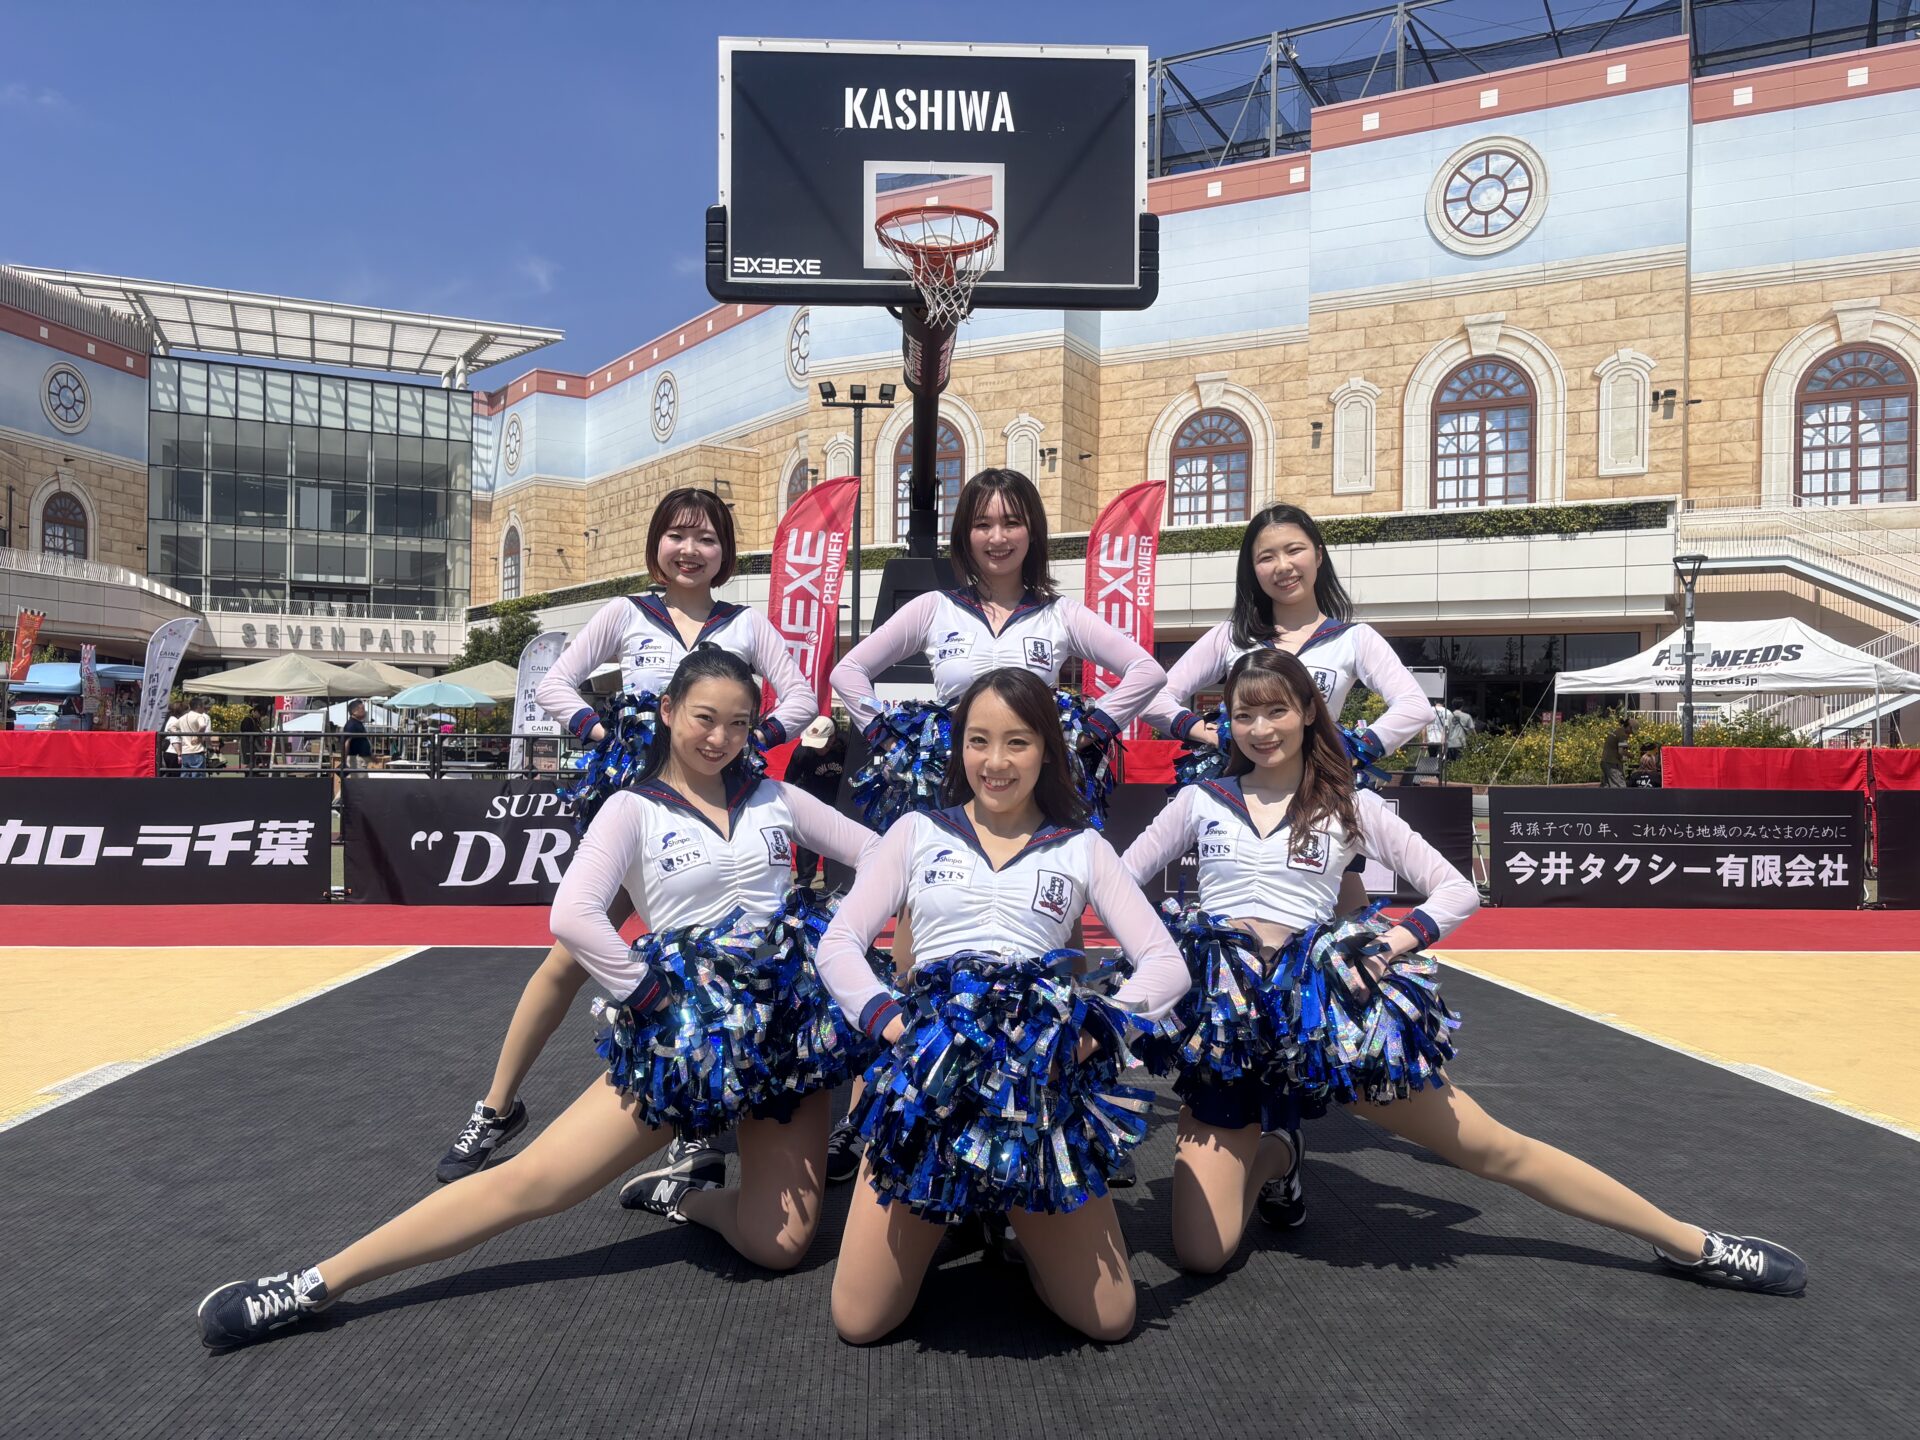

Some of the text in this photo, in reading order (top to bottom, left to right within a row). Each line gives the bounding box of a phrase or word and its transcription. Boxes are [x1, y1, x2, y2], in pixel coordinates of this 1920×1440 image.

[844, 87, 1015, 132] KASHIWA
[822, 531, 845, 604] PREMIER
[1137, 535, 1153, 606] PREMIER
[241, 623, 437, 653] SEVEN PARK
[645, 656, 665, 664] STS
[946, 647, 965, 656] STS
[1664, 661, 1782, 673] WEDERS POINT
[485, 793, 581, 819] SUPE
[0, 819, 315, 866] カローラ千葉
[1209, 844, 1231, 854] STS
[675, 849, 701, 866] STS
[1505, 850, 1849, 888] 今井タクシー有限会社
[937, 870, 965, 880] STS
